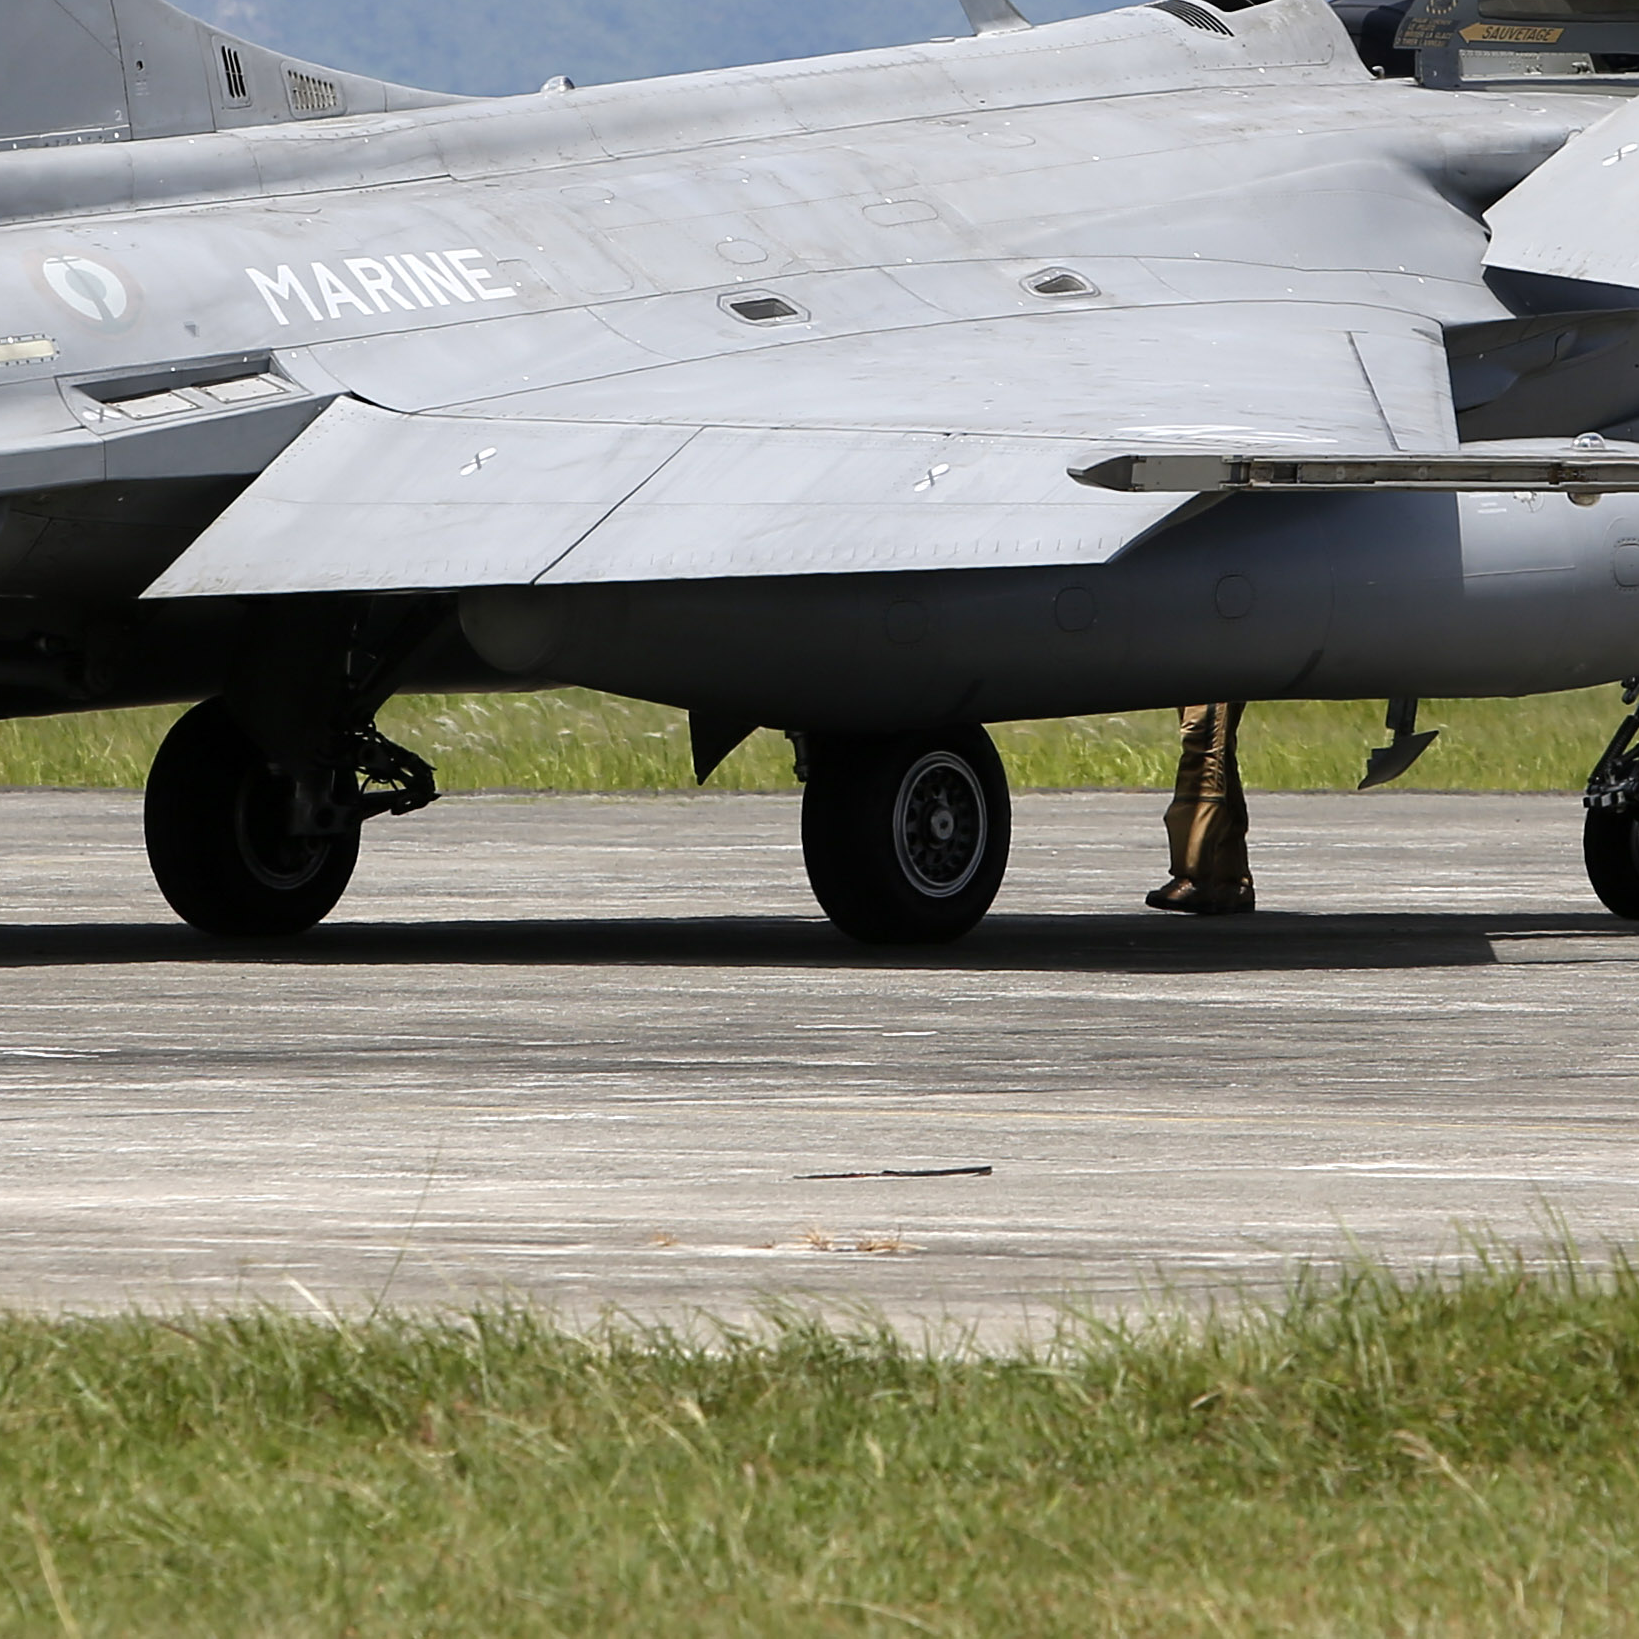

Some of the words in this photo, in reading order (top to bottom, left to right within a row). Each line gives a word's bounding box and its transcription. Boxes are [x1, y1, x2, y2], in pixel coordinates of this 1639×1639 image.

[1482, 25, 1553, 42] SAUVETAGE
[115, 109, 123, 121] 2
[244, 248, 518, 326] MARINE
